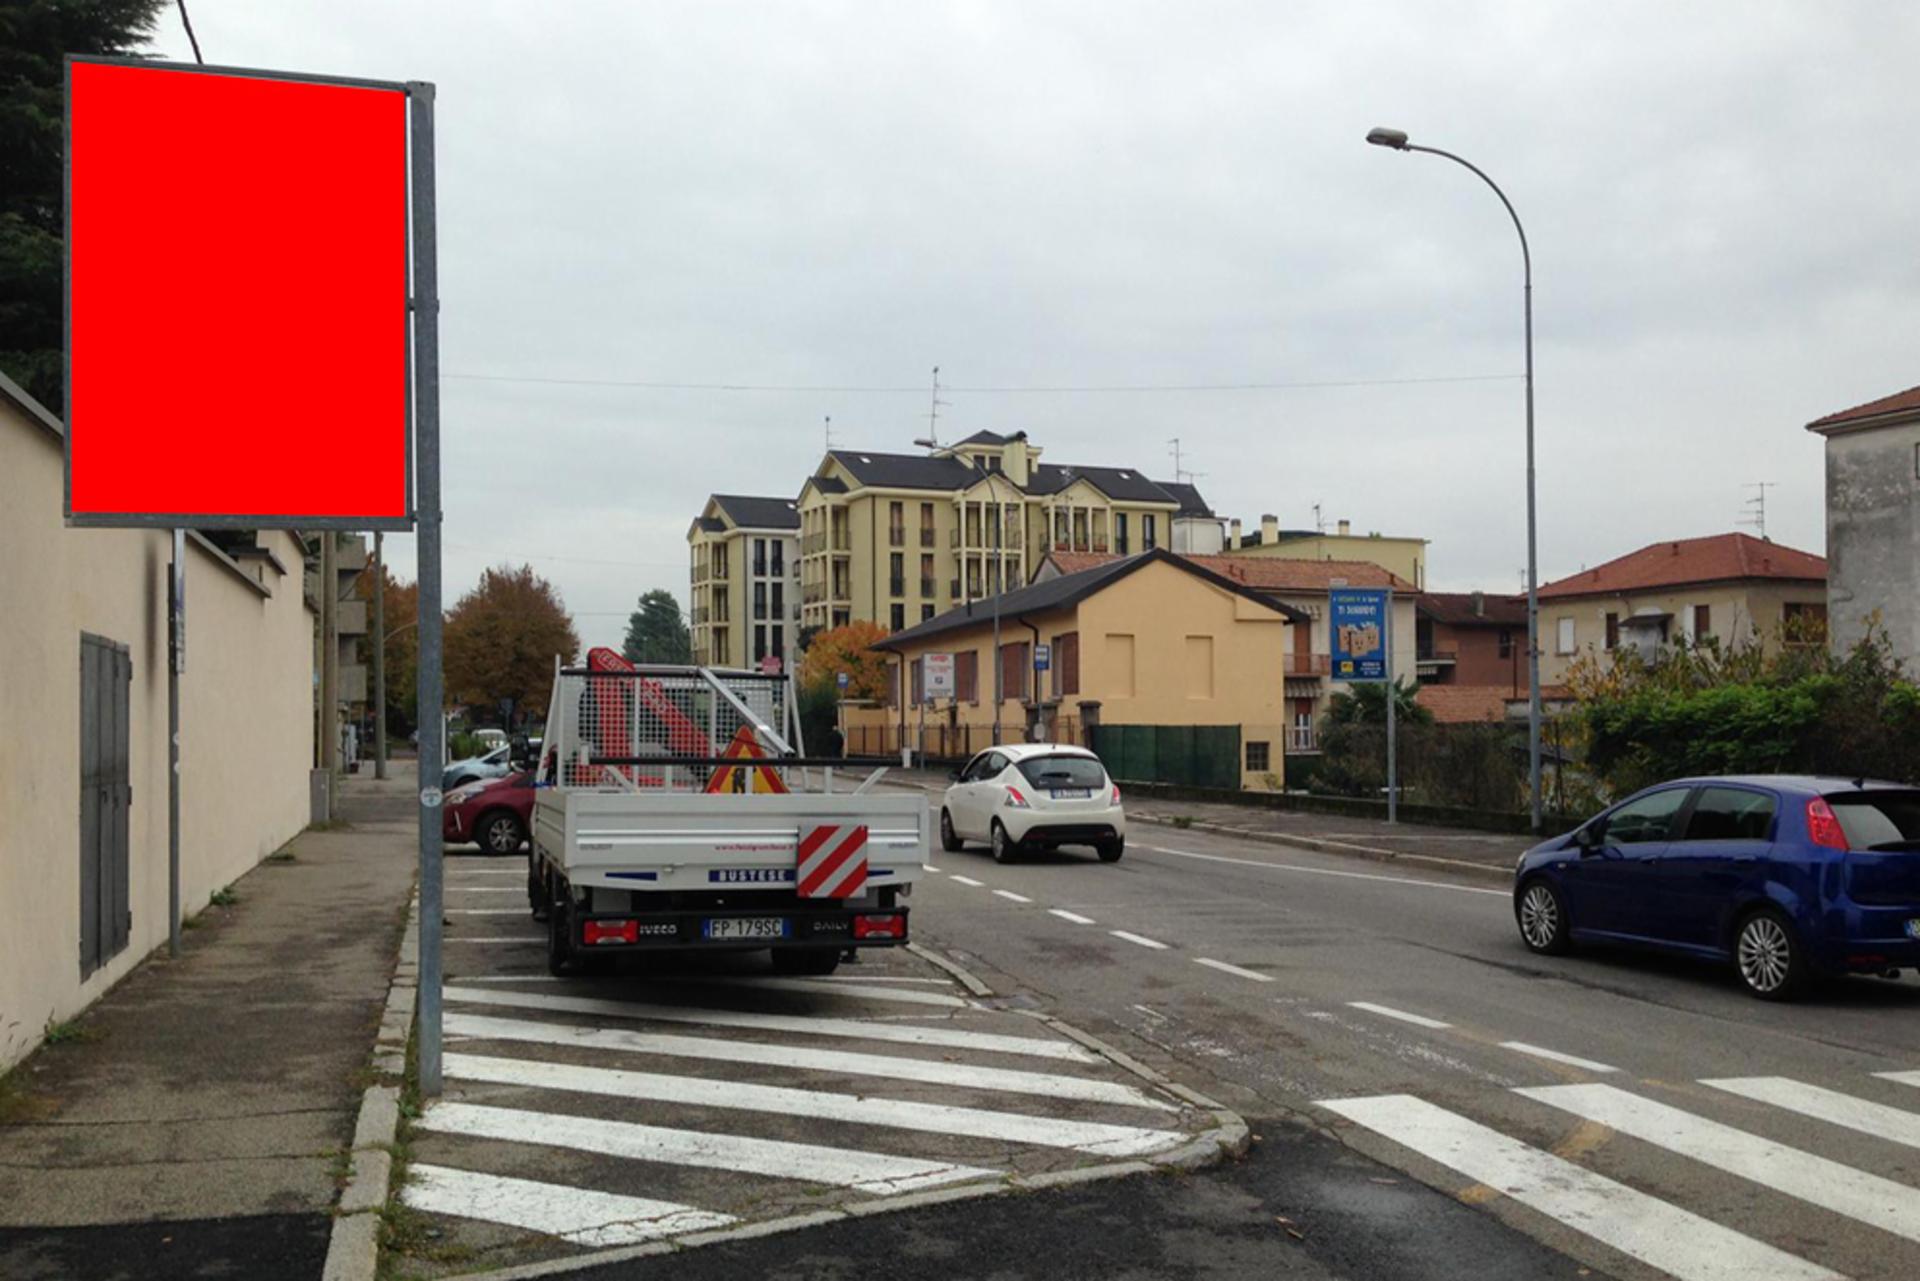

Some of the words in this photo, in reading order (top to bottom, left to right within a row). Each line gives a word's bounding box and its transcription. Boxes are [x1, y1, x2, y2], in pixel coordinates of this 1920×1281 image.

[719, 869, 785, 881] BUSTESE
[639, 924, 677, 934] IVECO
[813, 921, 848, 931] DAILY
